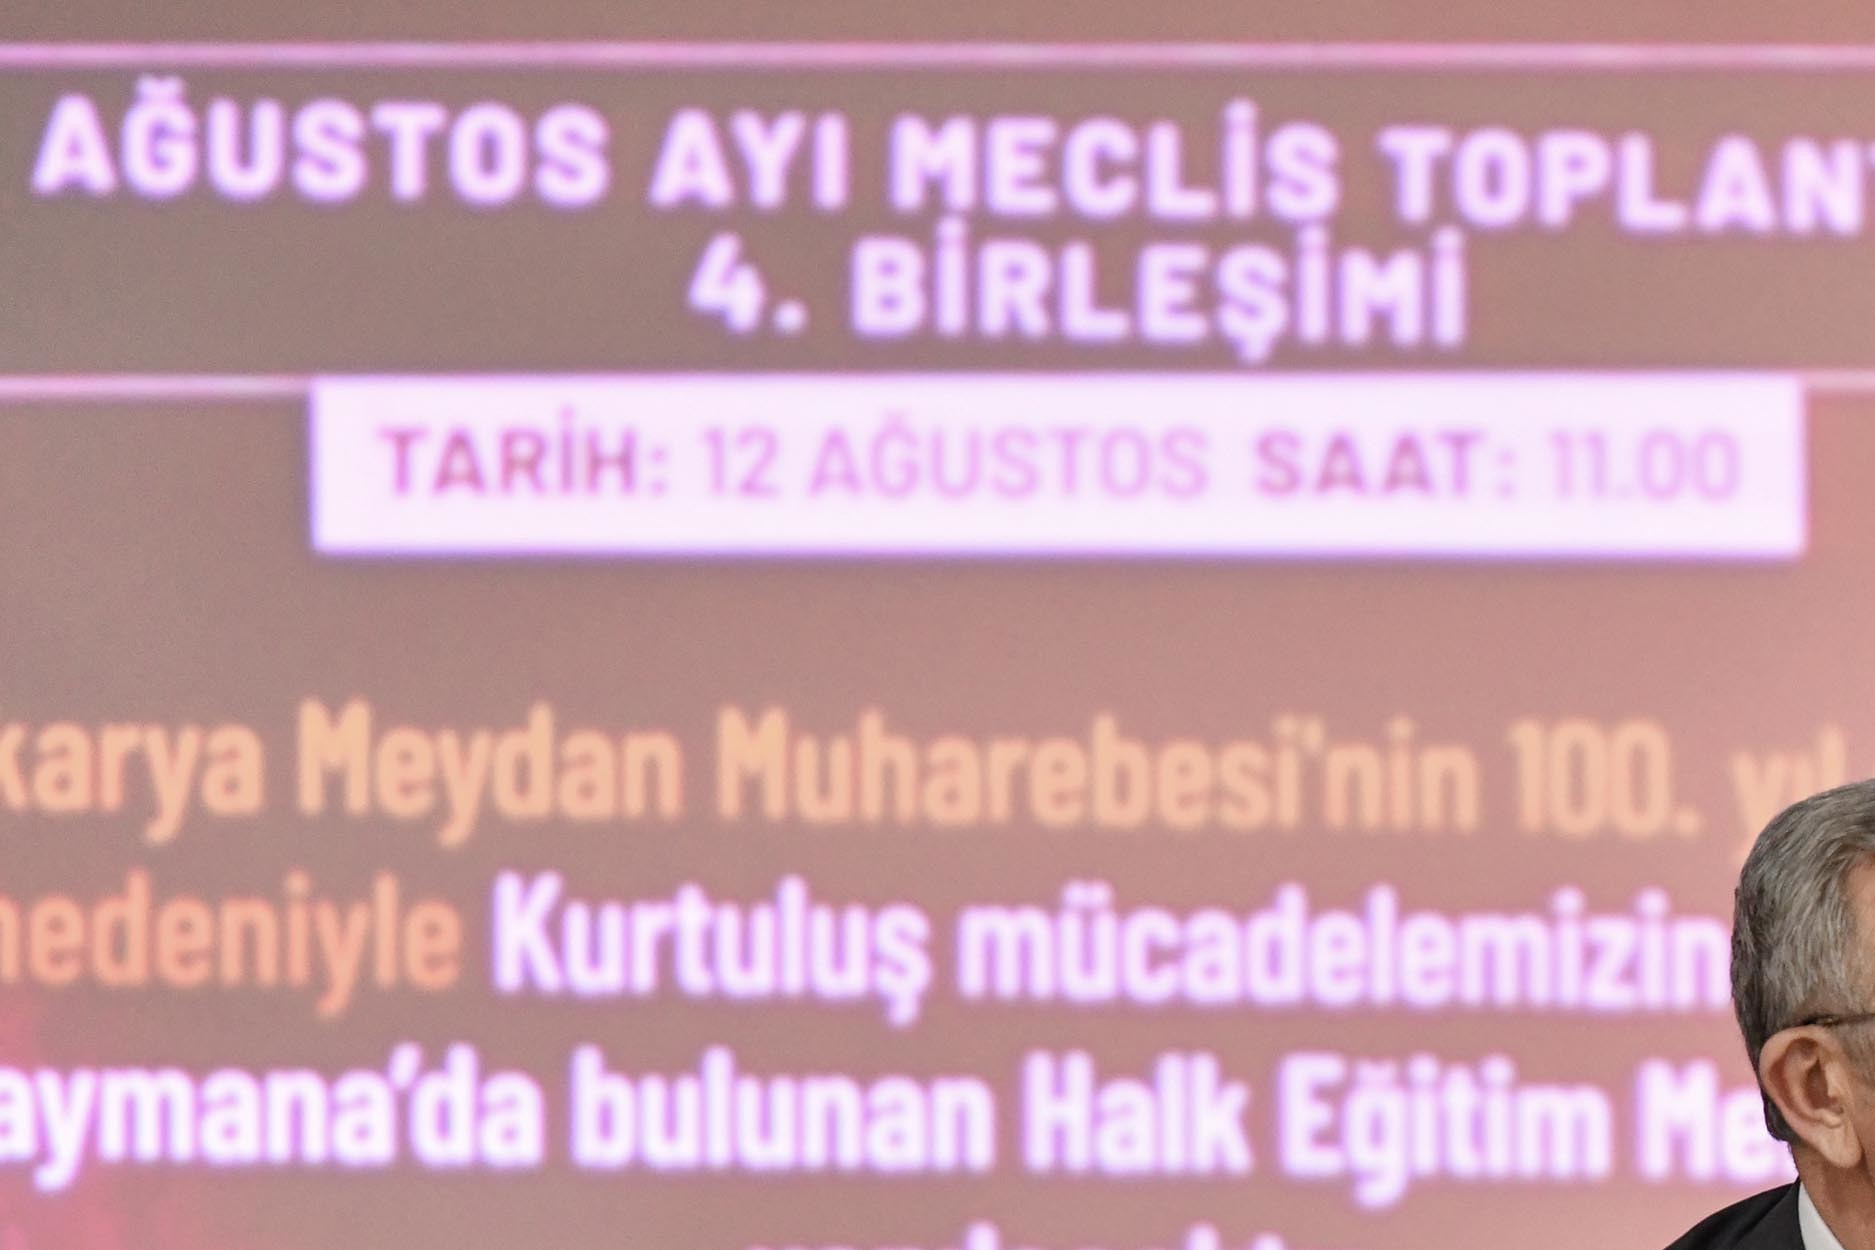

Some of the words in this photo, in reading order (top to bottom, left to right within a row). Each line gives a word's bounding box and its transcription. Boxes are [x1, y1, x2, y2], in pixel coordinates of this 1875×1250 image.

[31, 75, 613, 203] AĞUSTOS
[648, 109, 850, 211] AYI
[890, 97, 1342, 223] MECLİS
[688, 232, 810, 336] 4.
[850, 213, 1468, 363] BİRLEŞİMİ
[375, 402, 671, 497] TARİH:
[700, 424, 782, 498] 12
[805, 409, 1212, 500] AĞUSTOS
[1253, 427, 1517, 500] SAAT:
[1549, 427, 1744, 502] 11.00
[295, 698, 685, 847] Meydan
[716, 705, 1480, 833] Muharebesi'nin
[1506, 714, 1702, 838] 100.
[491, 870, 936, 1026] Kurtuluş
[955, 878, 1732, 1015] mücadelemizin
[569, 1043, 998, 1173] bulunan
[1020, 1050, 1253, 1176] Halk
[1276, 1052, 1614, 1212] Eğitim
